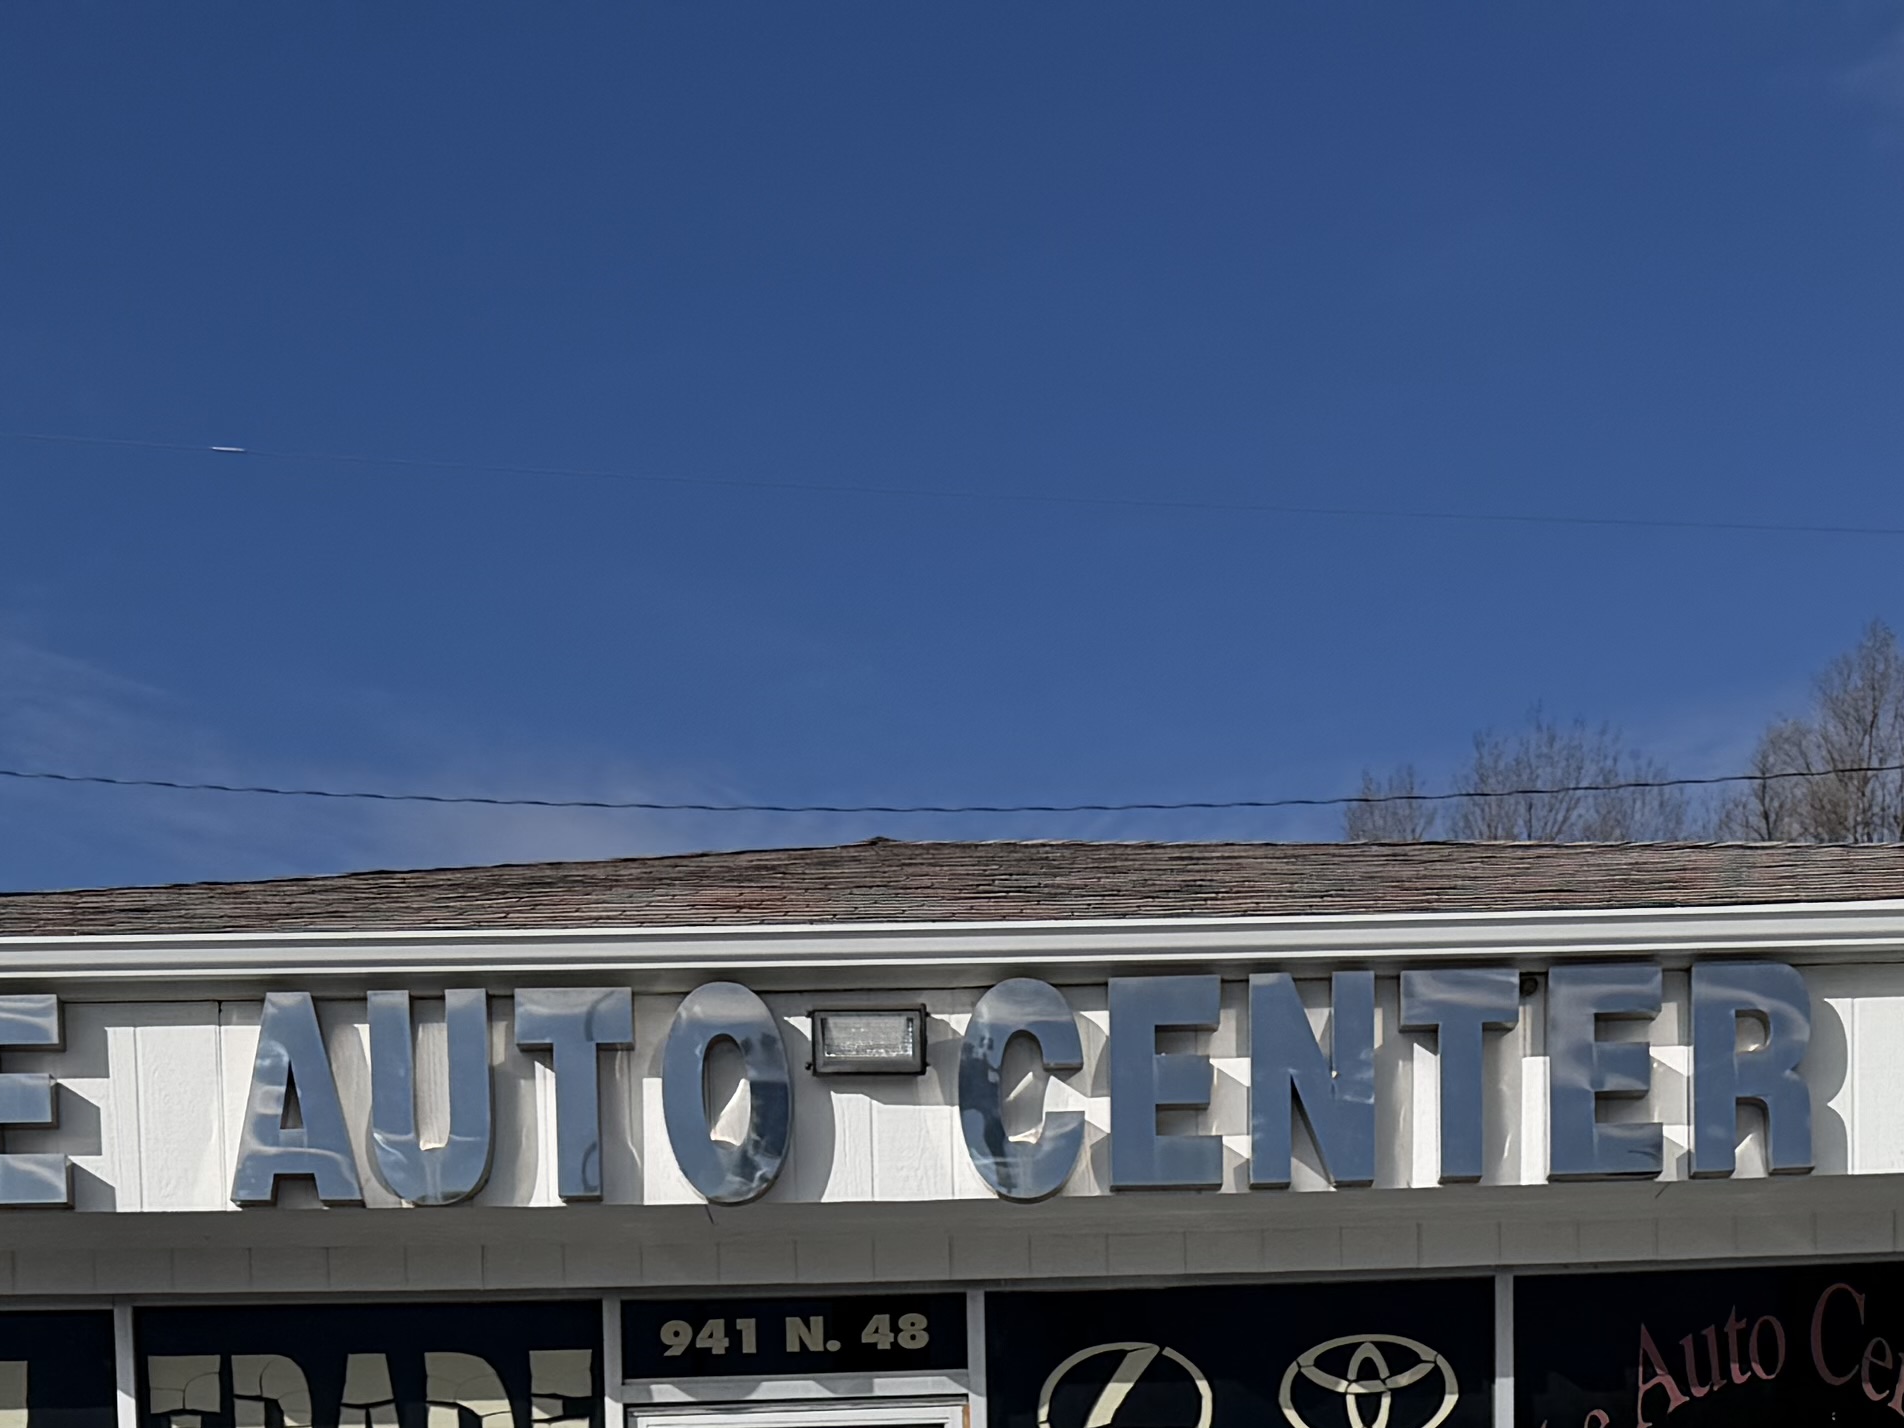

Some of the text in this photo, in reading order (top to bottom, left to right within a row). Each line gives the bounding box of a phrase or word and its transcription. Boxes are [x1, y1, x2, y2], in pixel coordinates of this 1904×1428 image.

[230, 982, 793, 1208] AUTO
[958, 961, 1815, 1203] CENTER
[660, 1312, 930, 1357] 941 N. 48
